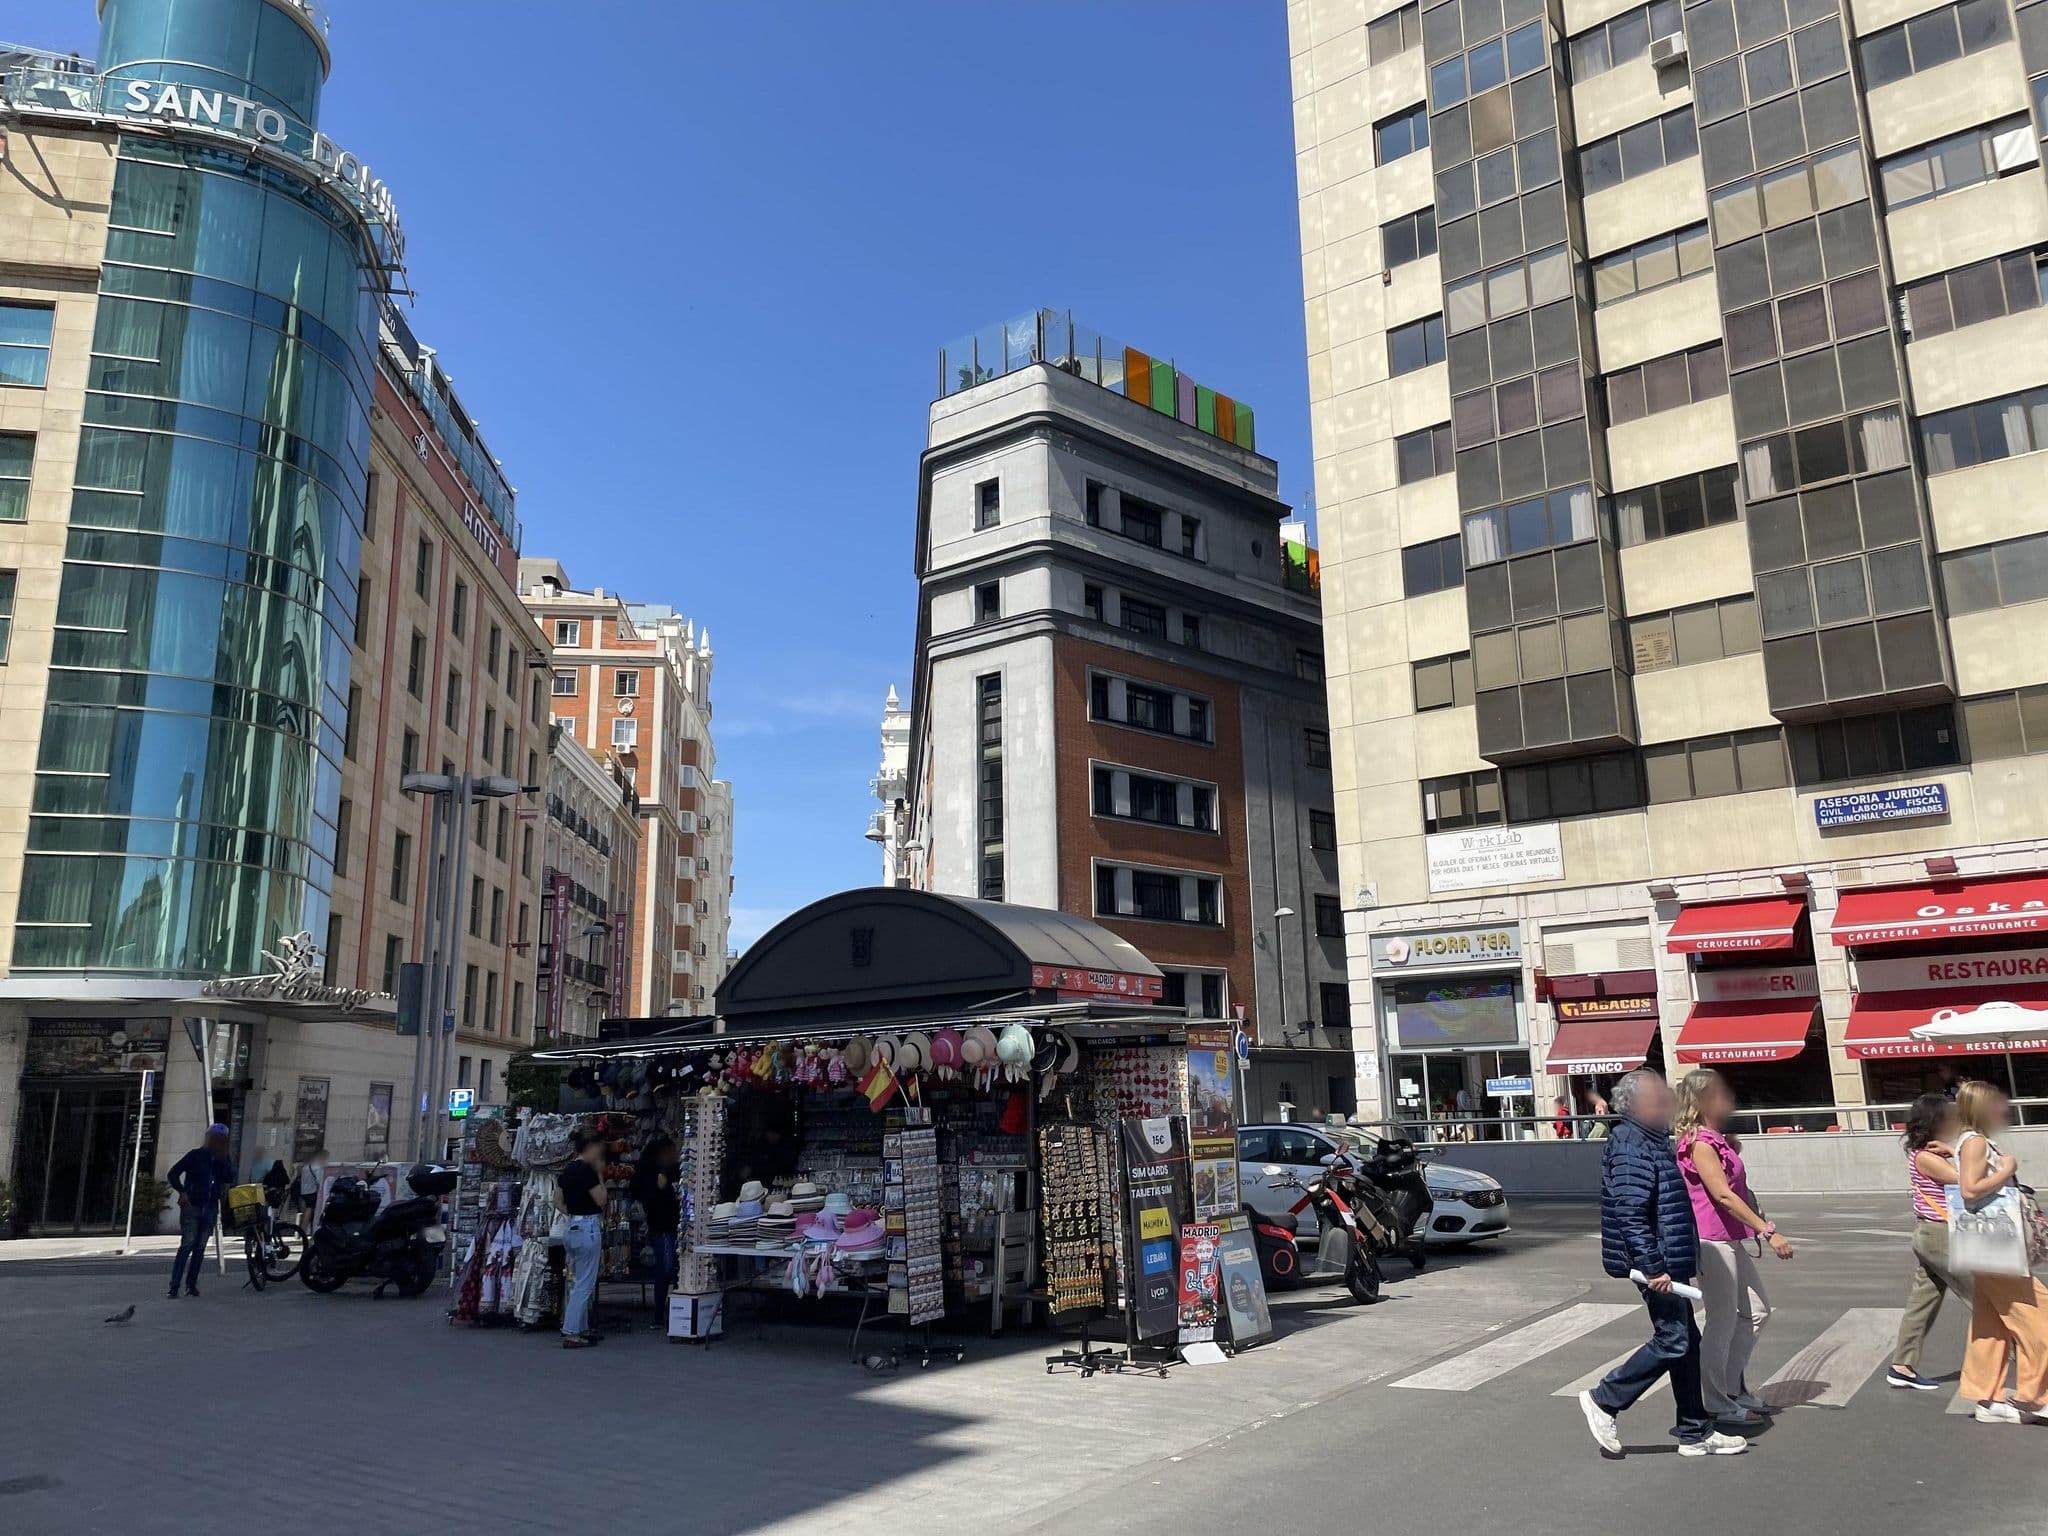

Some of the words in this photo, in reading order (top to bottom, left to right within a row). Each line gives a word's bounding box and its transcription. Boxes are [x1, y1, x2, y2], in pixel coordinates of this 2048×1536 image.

[124, 80, 288, 143] SANTO
[1819, 793, 1880, 809] ASESORIA
[1885, 785, 1940, 801] JURIDICA
[1820, 808, 1844, 817] CIVIL
[1852, 801, 1897, 814] LABORAL
[1906, 796, 1941, 807] FISCAL
[1821, 811, 1880, 825] MATRIMONIAL
[1882, 803, 1943, 818] COMUNIDADES
[1496, 831, 1522, 846] Lab
[1431, 868, 1441, 876] POR
[1503, 859, 1527, 868] OFICINAS
[1530, 855, 1559, 865] VIRTUALES
[1433, 859, 1457, 868] ALQUILER
[1468, 855, 1492, 864] OFICINAS
[1526, 847, 1556, 857] REUNIONES
[1848, 928, 1919, 942] CAFETERÍA
[1949, 919, 2038, 933] RESTAURANTE
[615, 921, 625, 971] PETIT
[1414, 934, 1471, 957] FLORA
[1477, 931, 1511, 952] TEA
[1696, 938, 1761, 949] CERVECERÍA
[1088, 972, 1115, 985] MADRID
[1928, 957, 2048, 981] RESTAURA
[1580, 998, 1651, 1012] TABACOS
[1702, 1049, 1777, 1059] RESTAURANTE
[1862, 1043, 1935, 1055] CAFETERÍA
[1567, 1062, 1623, 1074] ESTANCO
[454, 1091, 469, 1108] P
[1131, 1167, 1146, 1179] SIM
[1147, 1165, 1169, 1177] CARDS
[1182, 1227, 1219, 1238] MADRID
